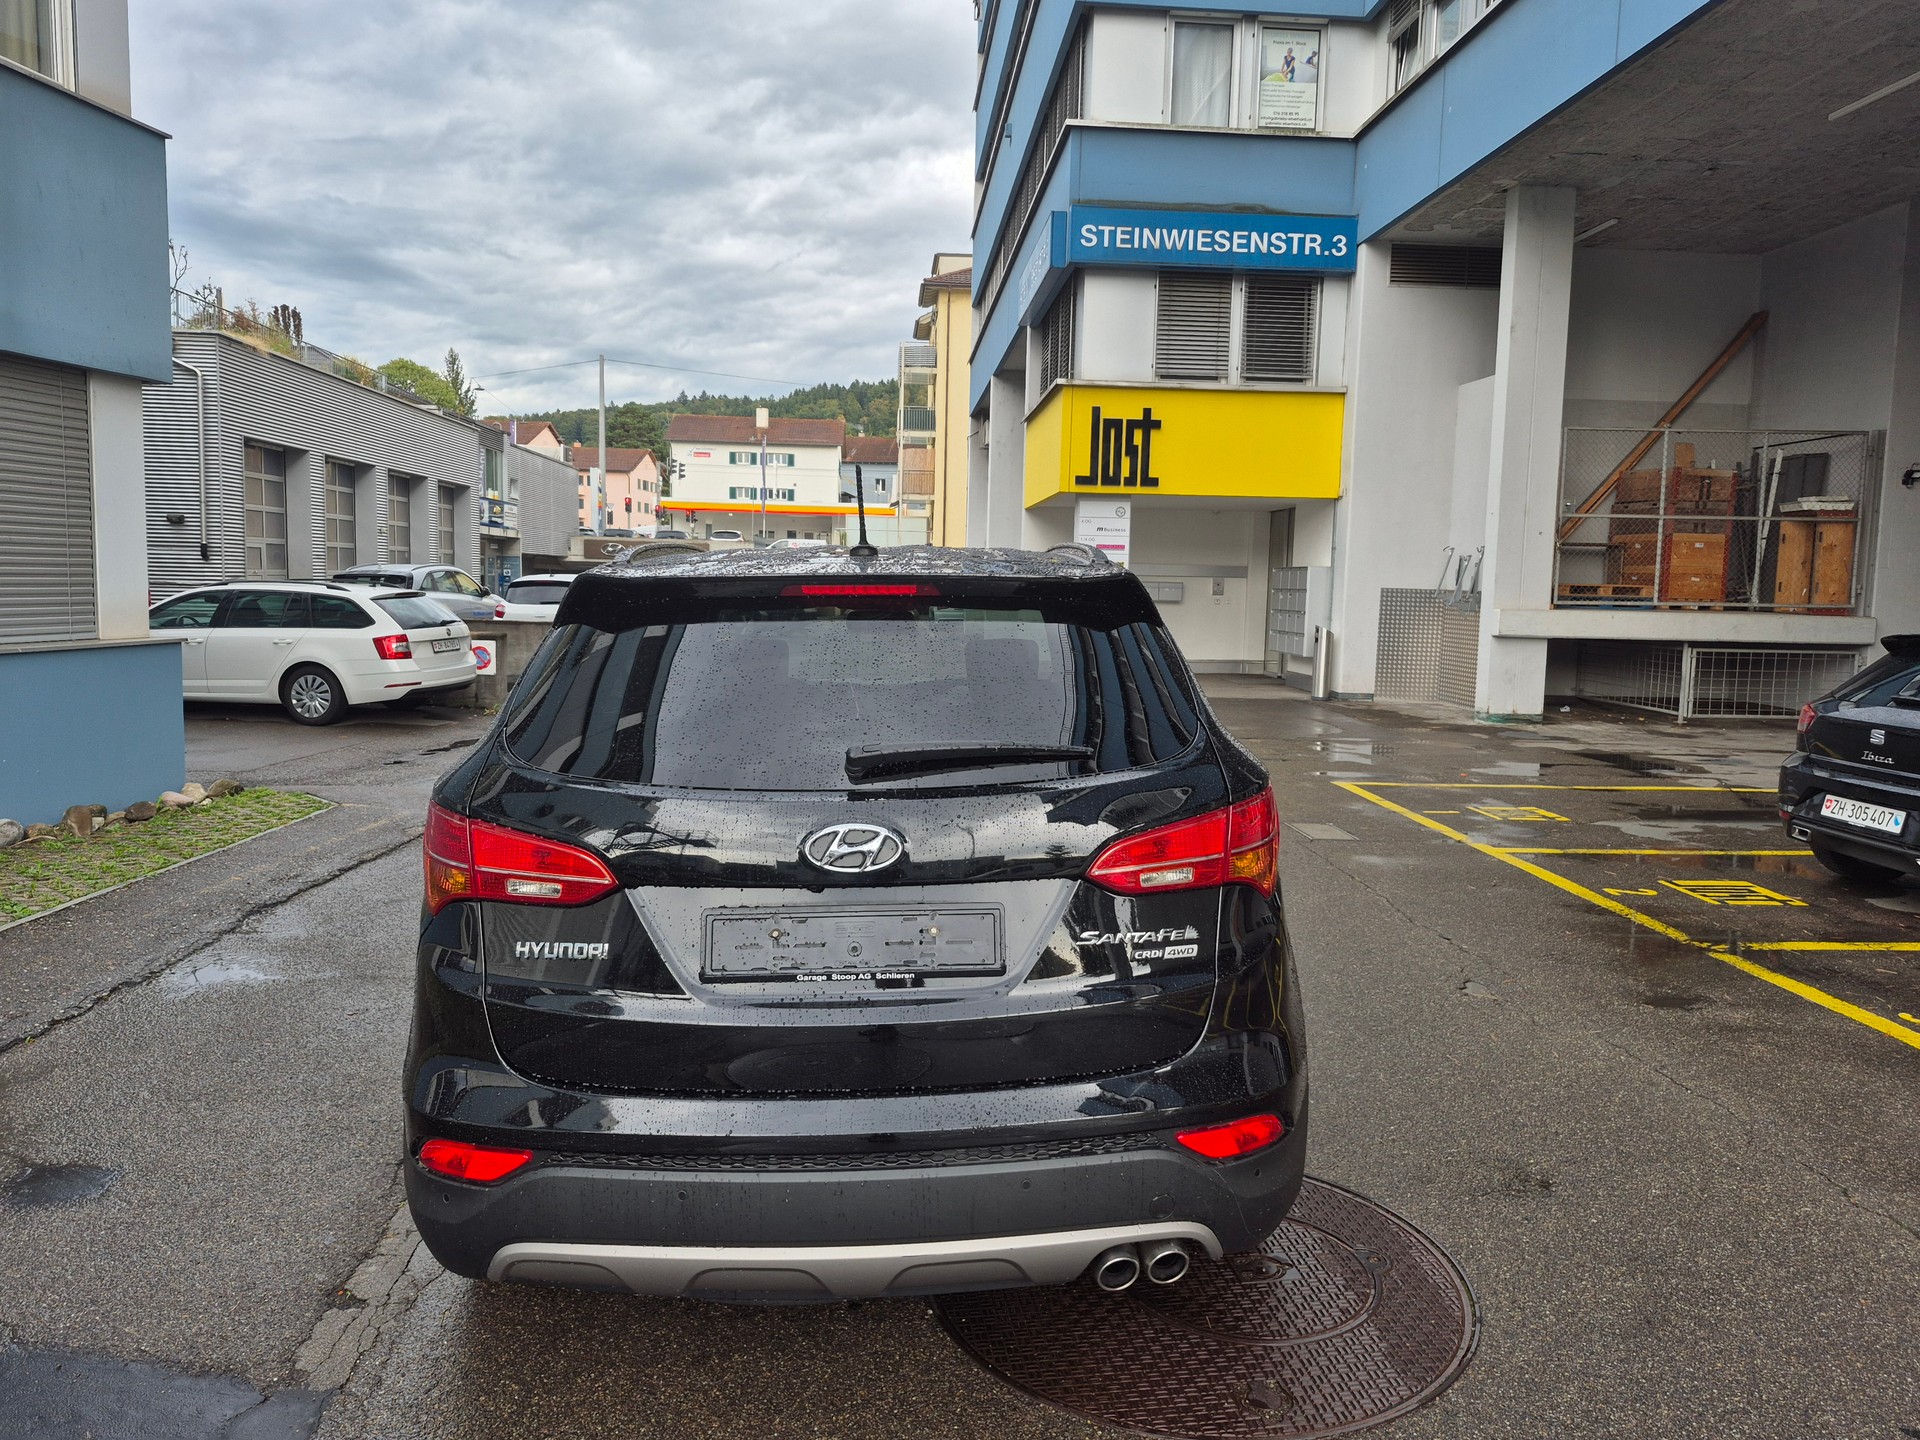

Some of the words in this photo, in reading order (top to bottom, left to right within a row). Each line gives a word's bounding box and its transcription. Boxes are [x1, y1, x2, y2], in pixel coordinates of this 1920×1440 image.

[1861, 751, 1895, 764] Ibiza
[515, 941, 610, 960] HYUNDAI
[1134, 949, 1163, 960] CRDi
[1167, 947, 1194, 956] 4WD
[796, 974, 827, 982] Garage
[831, 973, 857, 981] Stoop
[875, 972, 915, 980] Schlieren
